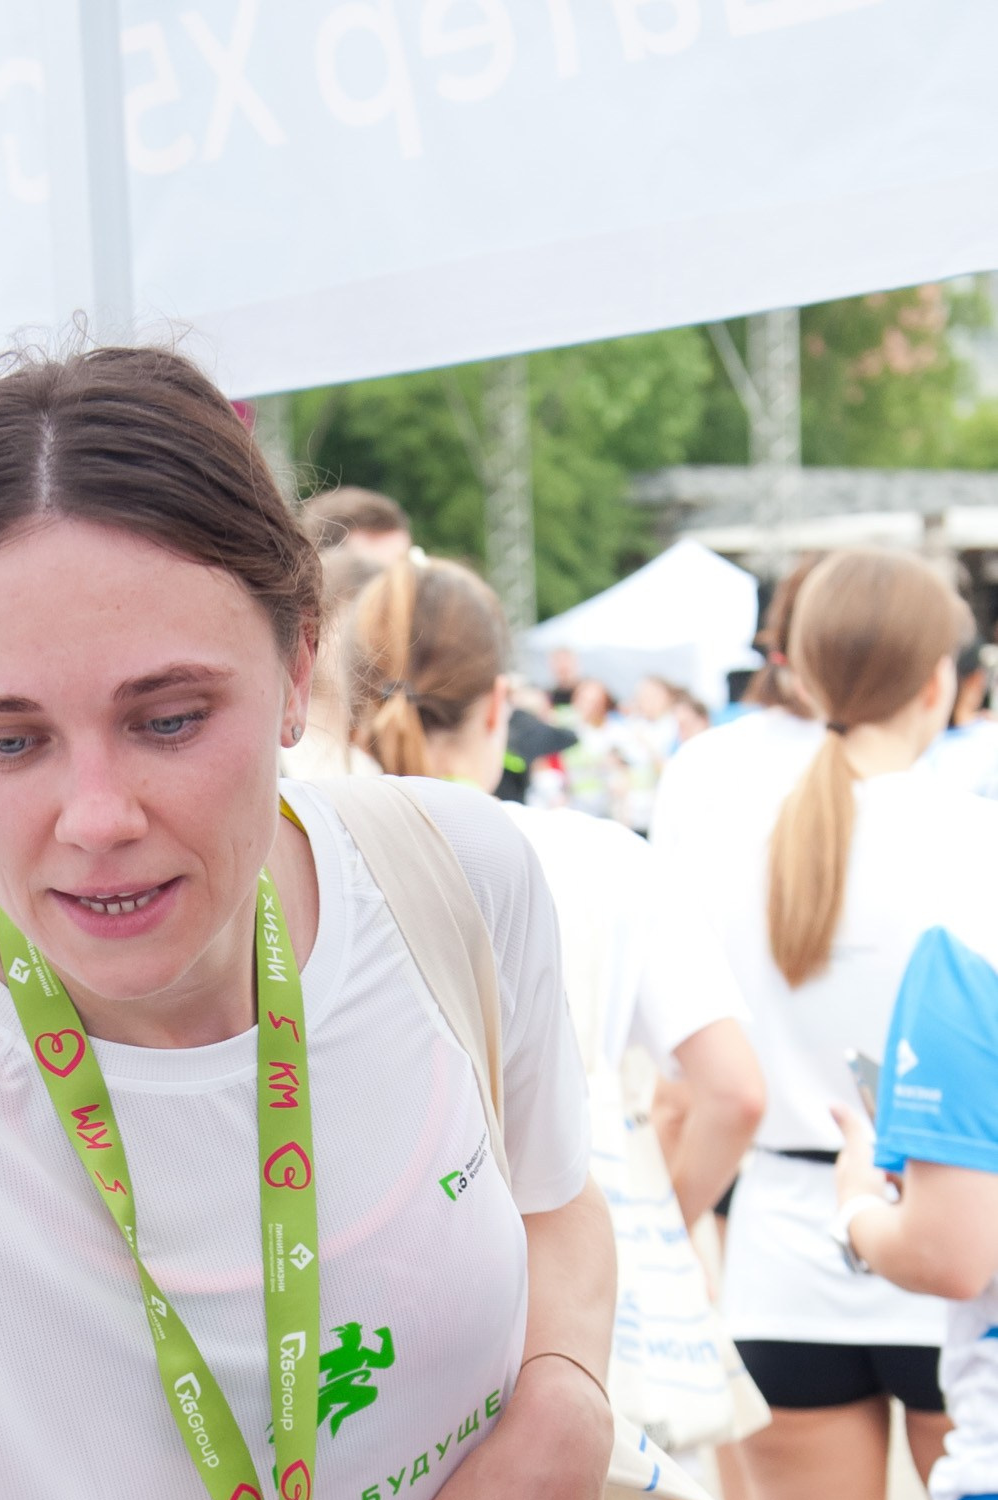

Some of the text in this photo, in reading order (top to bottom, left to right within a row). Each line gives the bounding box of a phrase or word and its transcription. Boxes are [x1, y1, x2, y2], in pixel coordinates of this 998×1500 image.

[268, 1010, 300, 1109] 5 КМ
[71, 1103, 127, 1196] 5 КМ
